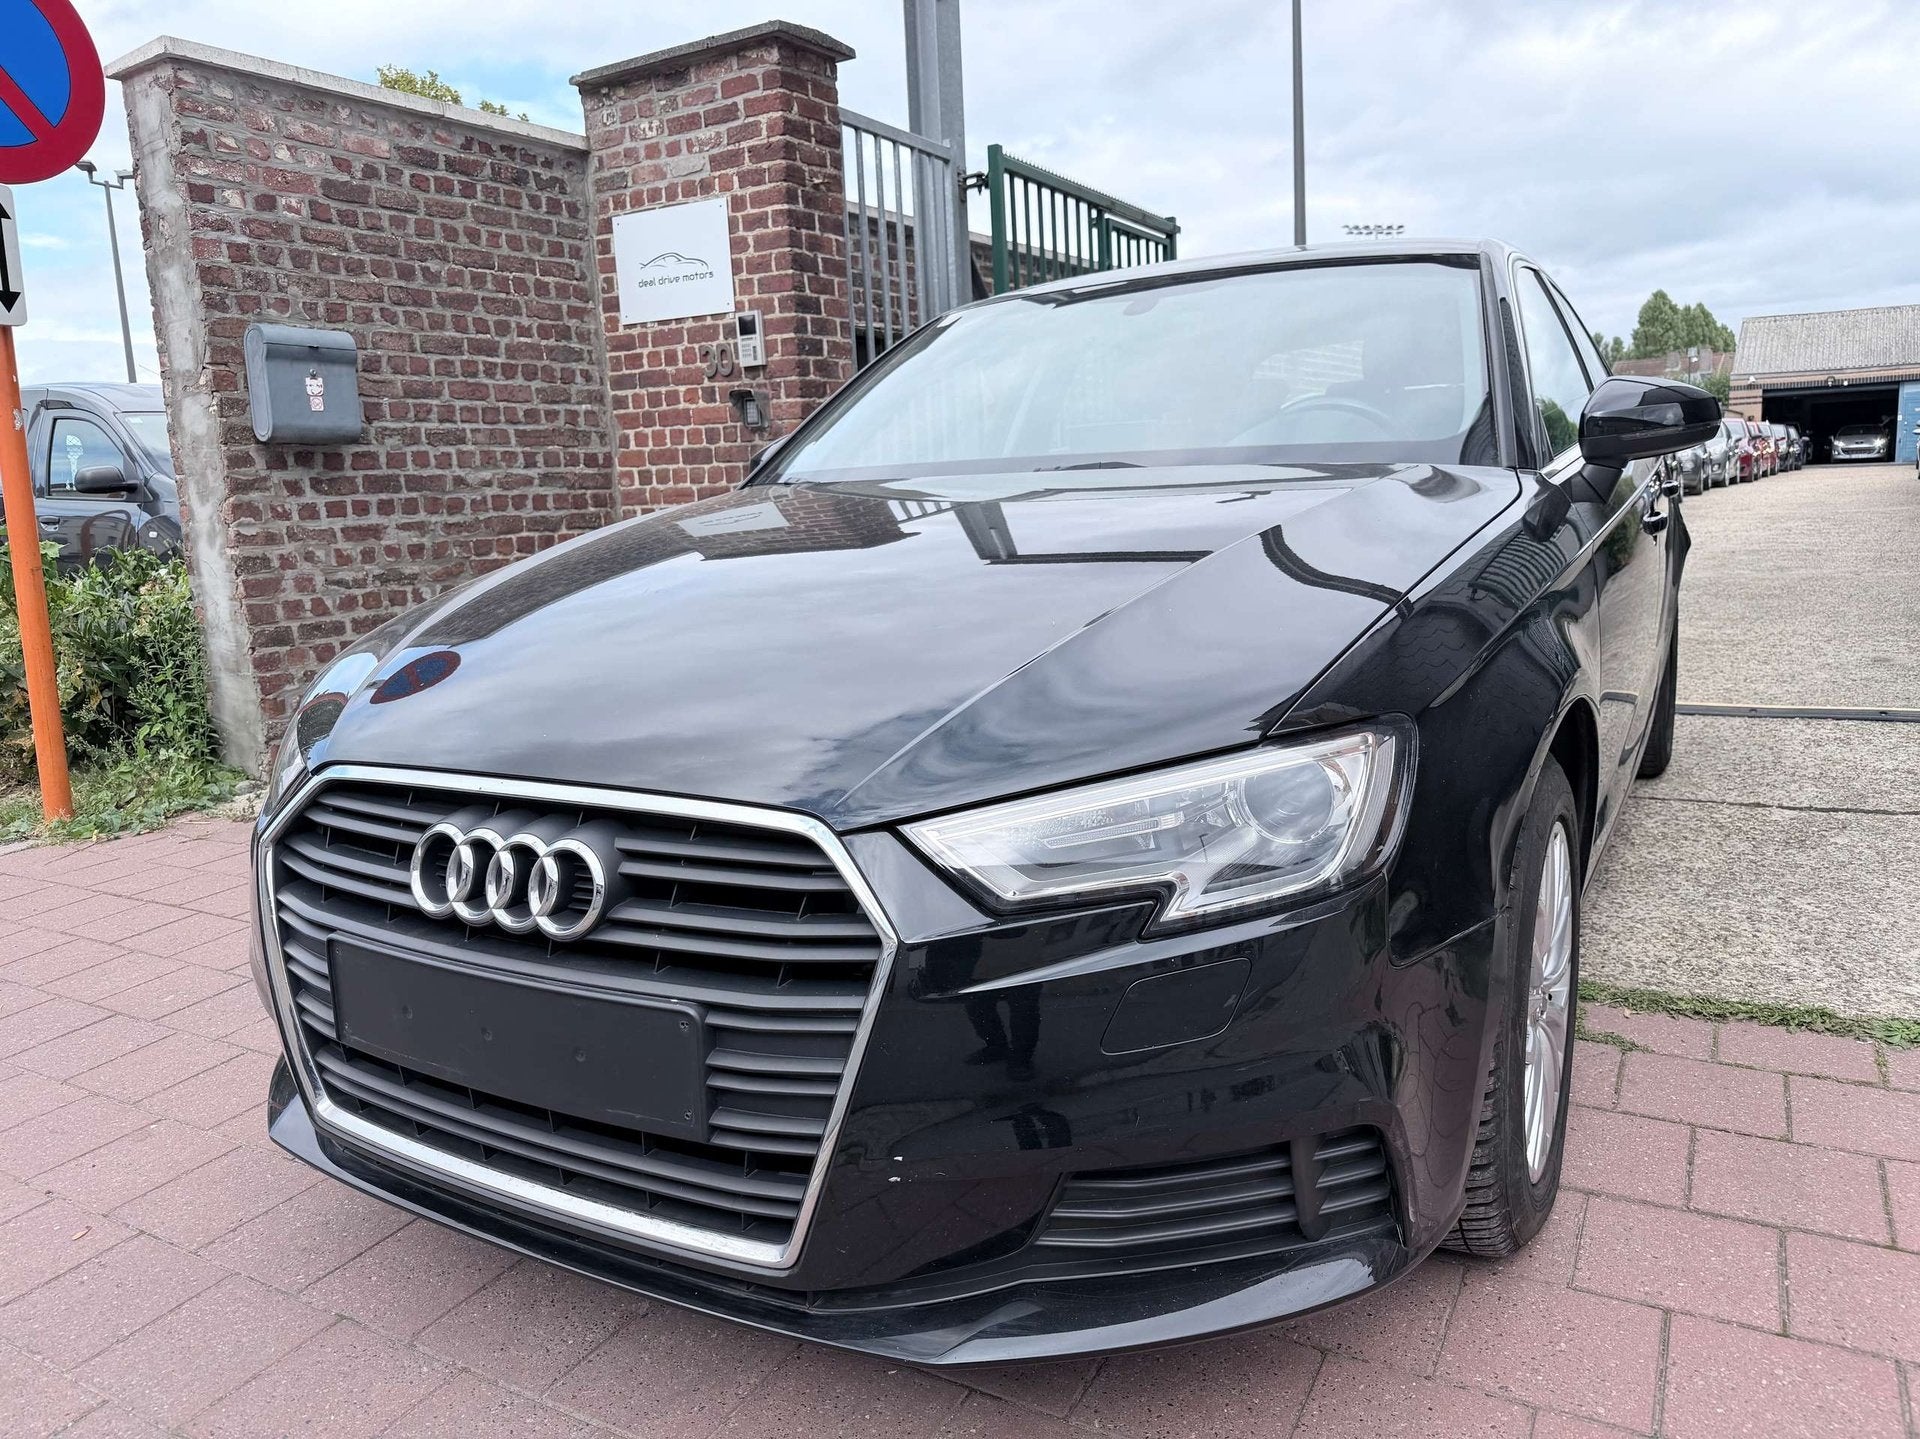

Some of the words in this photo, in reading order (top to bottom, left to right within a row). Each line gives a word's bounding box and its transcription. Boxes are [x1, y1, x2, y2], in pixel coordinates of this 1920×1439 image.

[658, 275, 680, 285] drive
[682, 271, 714, 282] motors
[701, 344, 734, 378] 30
